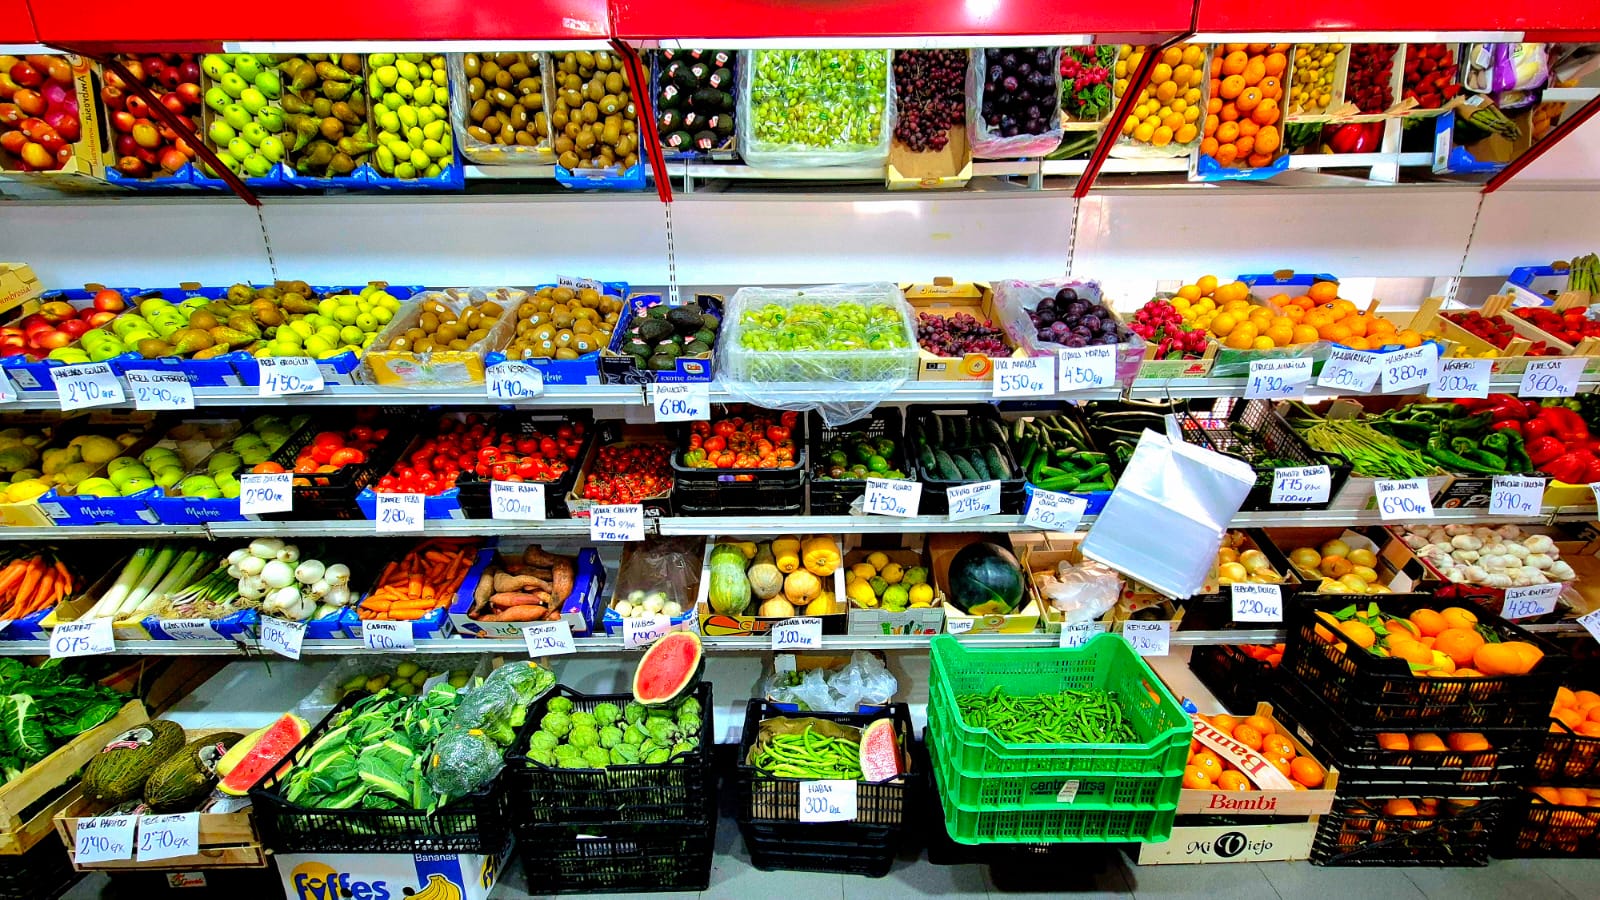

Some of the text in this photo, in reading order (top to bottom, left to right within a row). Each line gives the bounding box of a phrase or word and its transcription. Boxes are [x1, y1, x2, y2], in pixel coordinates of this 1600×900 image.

[1237, 599, 1263, 615] 2'20
[1208, 794, 1277, 811] Bambi
[1186, 831, 1273, 858] Mi Viejo
[415, 853, 458, 863] Bananas
